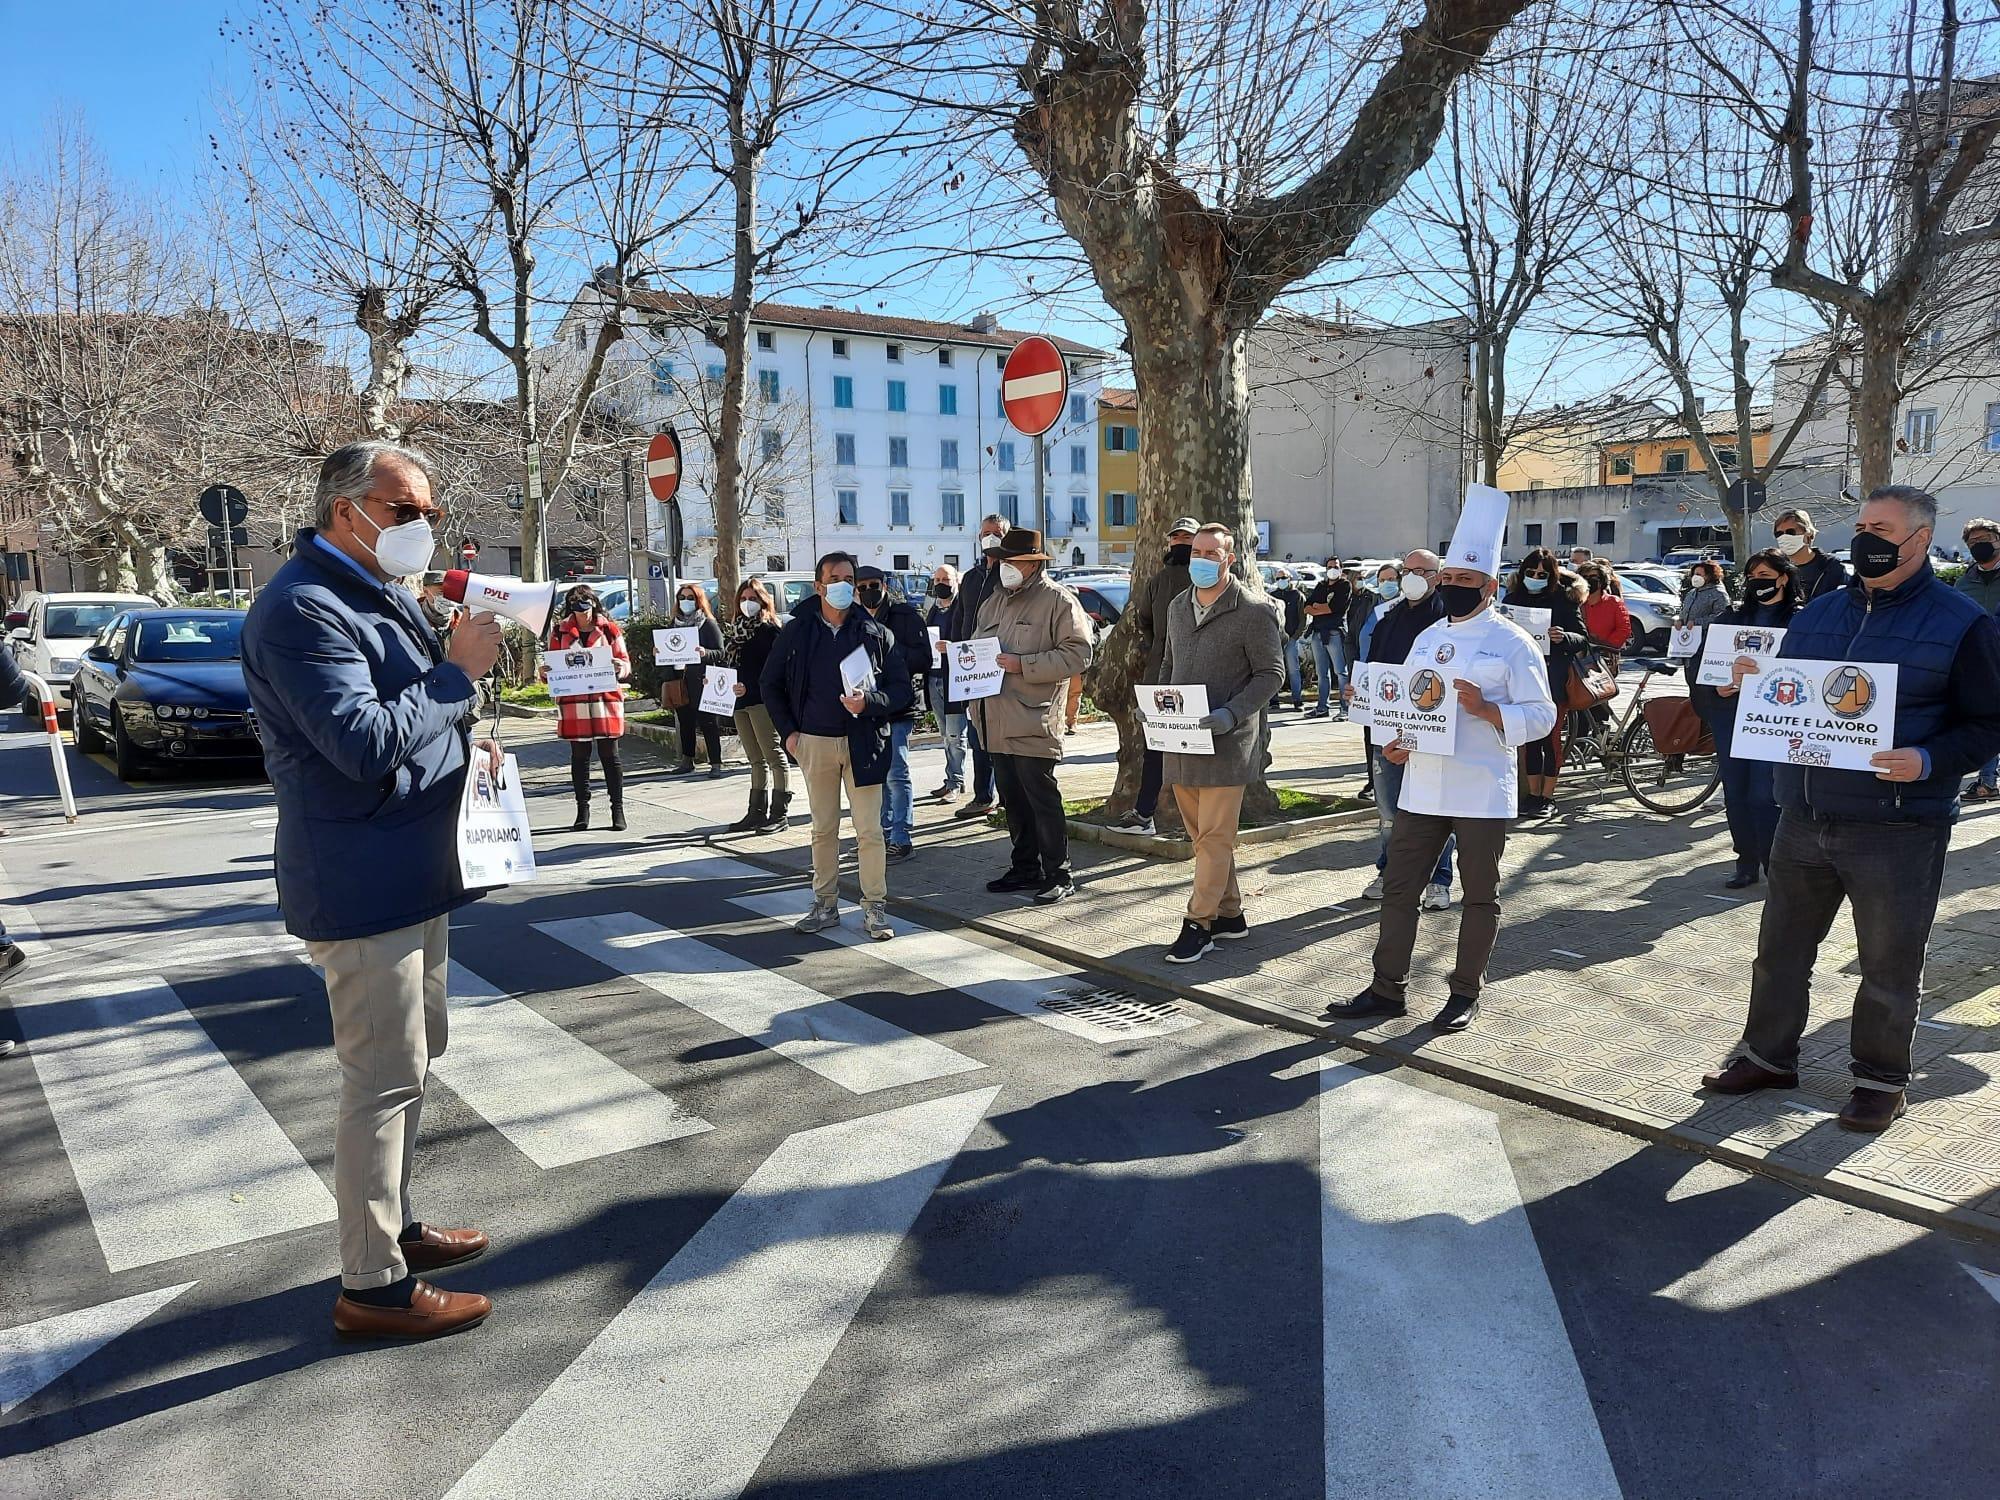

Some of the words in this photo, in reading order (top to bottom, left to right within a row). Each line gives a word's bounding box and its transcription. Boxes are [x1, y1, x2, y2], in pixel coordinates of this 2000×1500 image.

[652, 565, 660, 577] P
[483, 587, 510, 600] PYLE
[954, 670, 1001, 683] RIAPRIAMO!
[1373, 708, 1399, 719] SALUTE
[1400, 711, 1405, 719] E
[1406, 712, 1447, 723] LAVORO
[1373, 719, 1403, 729] POSSONO
[1403, 723, 1447, 733] CONVIVERE
[1745, 712, 1799, 726] SALUTE
[1803, 718, 1812, 727] E
[1816, 719, 1878, 733] LAVORO
[1742, 725, 1804, 739] POSSONO
[1807, 732, 1878, 746] CONVIVERE
[1787, 755, 1830, 766] TOSCANI
[1788, 749, 1832, 760] CUOCHI
[465, 827, 522, 844] RIAPRIAMO!
